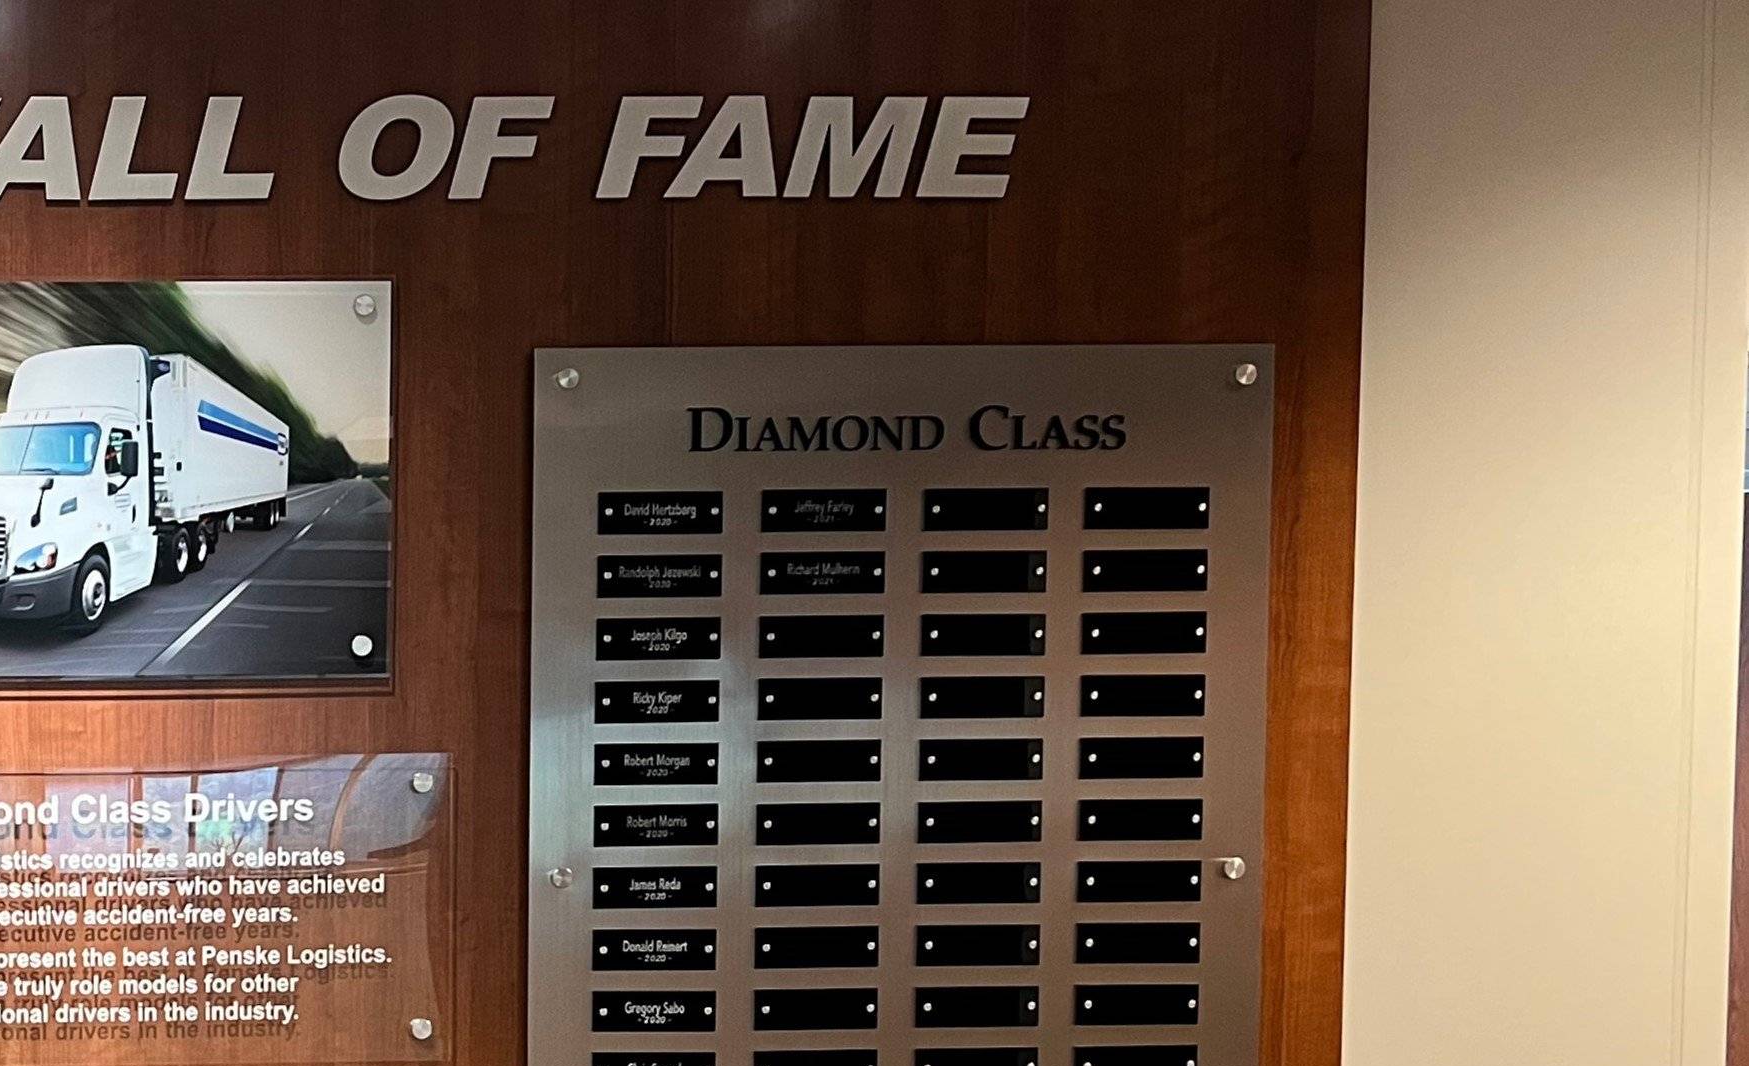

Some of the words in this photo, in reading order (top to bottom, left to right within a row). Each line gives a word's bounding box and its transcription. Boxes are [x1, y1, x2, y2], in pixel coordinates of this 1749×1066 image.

[337, 94, 556, 200] OF
[595, 95, 1031, 199] FAME
[686, 406, 945, 453] DIAMOND
[969, 404, 1127, 451] CLASS
[71, 793, 172, 825] Class
[184, 792, 314, 823] Drivers
[59, 849, 179, 874] recognizes
[185, 848, 226, 868] and
[232, 846, 346, 867] celebrates
[93, 877, 170, 897] drivers
[176, 875, 223, 896] who
[229, 875, 281, 895] have
[286, 873, 385, 894] achieved
[83, 904, 226, 926] accident-free
[232, 906, 298, 928] years.
[82, 948, 116, 968] the
[122, 946, 169, 967] best
[175, 947, 196, 967] at
[202, 945, 281, 966] Penske
[286, 944, 393, 969] Logistics.
[14, 975, 64, 1000] truly
[70, 975, 112, 996] role
[118, 974, 198, 995] models
[203, 973, 236, 994] for
[240, 973, 299, 994] other
[54, 1002, 131, 1023] drivers
[137, 1002, 158, 1022] in
[164, 1001, 199, 1021] the
[205, 1001, 300, 1025] industry.
